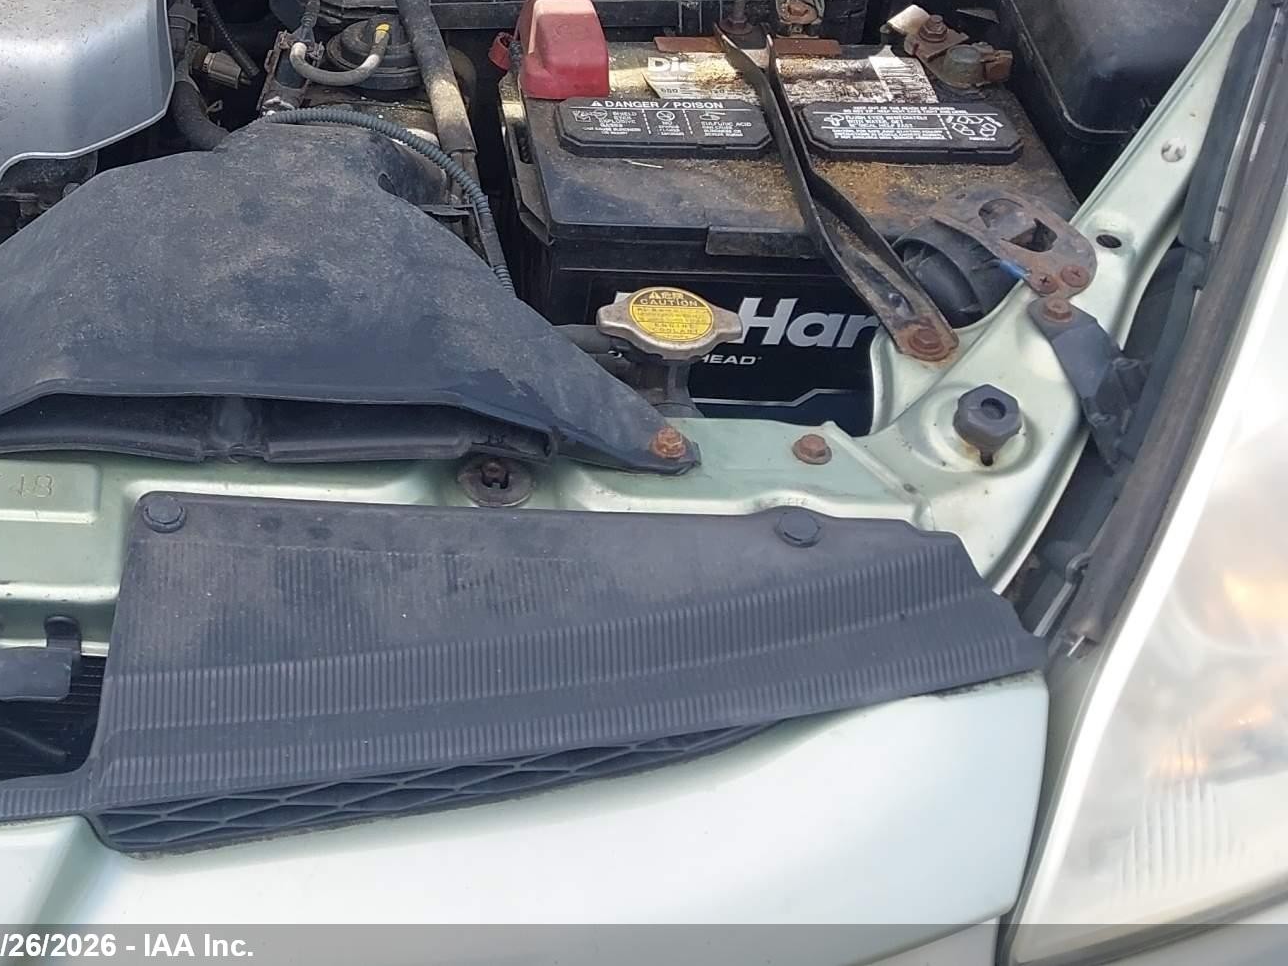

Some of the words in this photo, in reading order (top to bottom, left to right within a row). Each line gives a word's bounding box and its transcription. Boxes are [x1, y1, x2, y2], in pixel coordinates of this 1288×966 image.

[605, 100, 660, 108] DANGER
[673, 101, 724, 109] POISON
[640, 298, 698, 307] CAUTION
